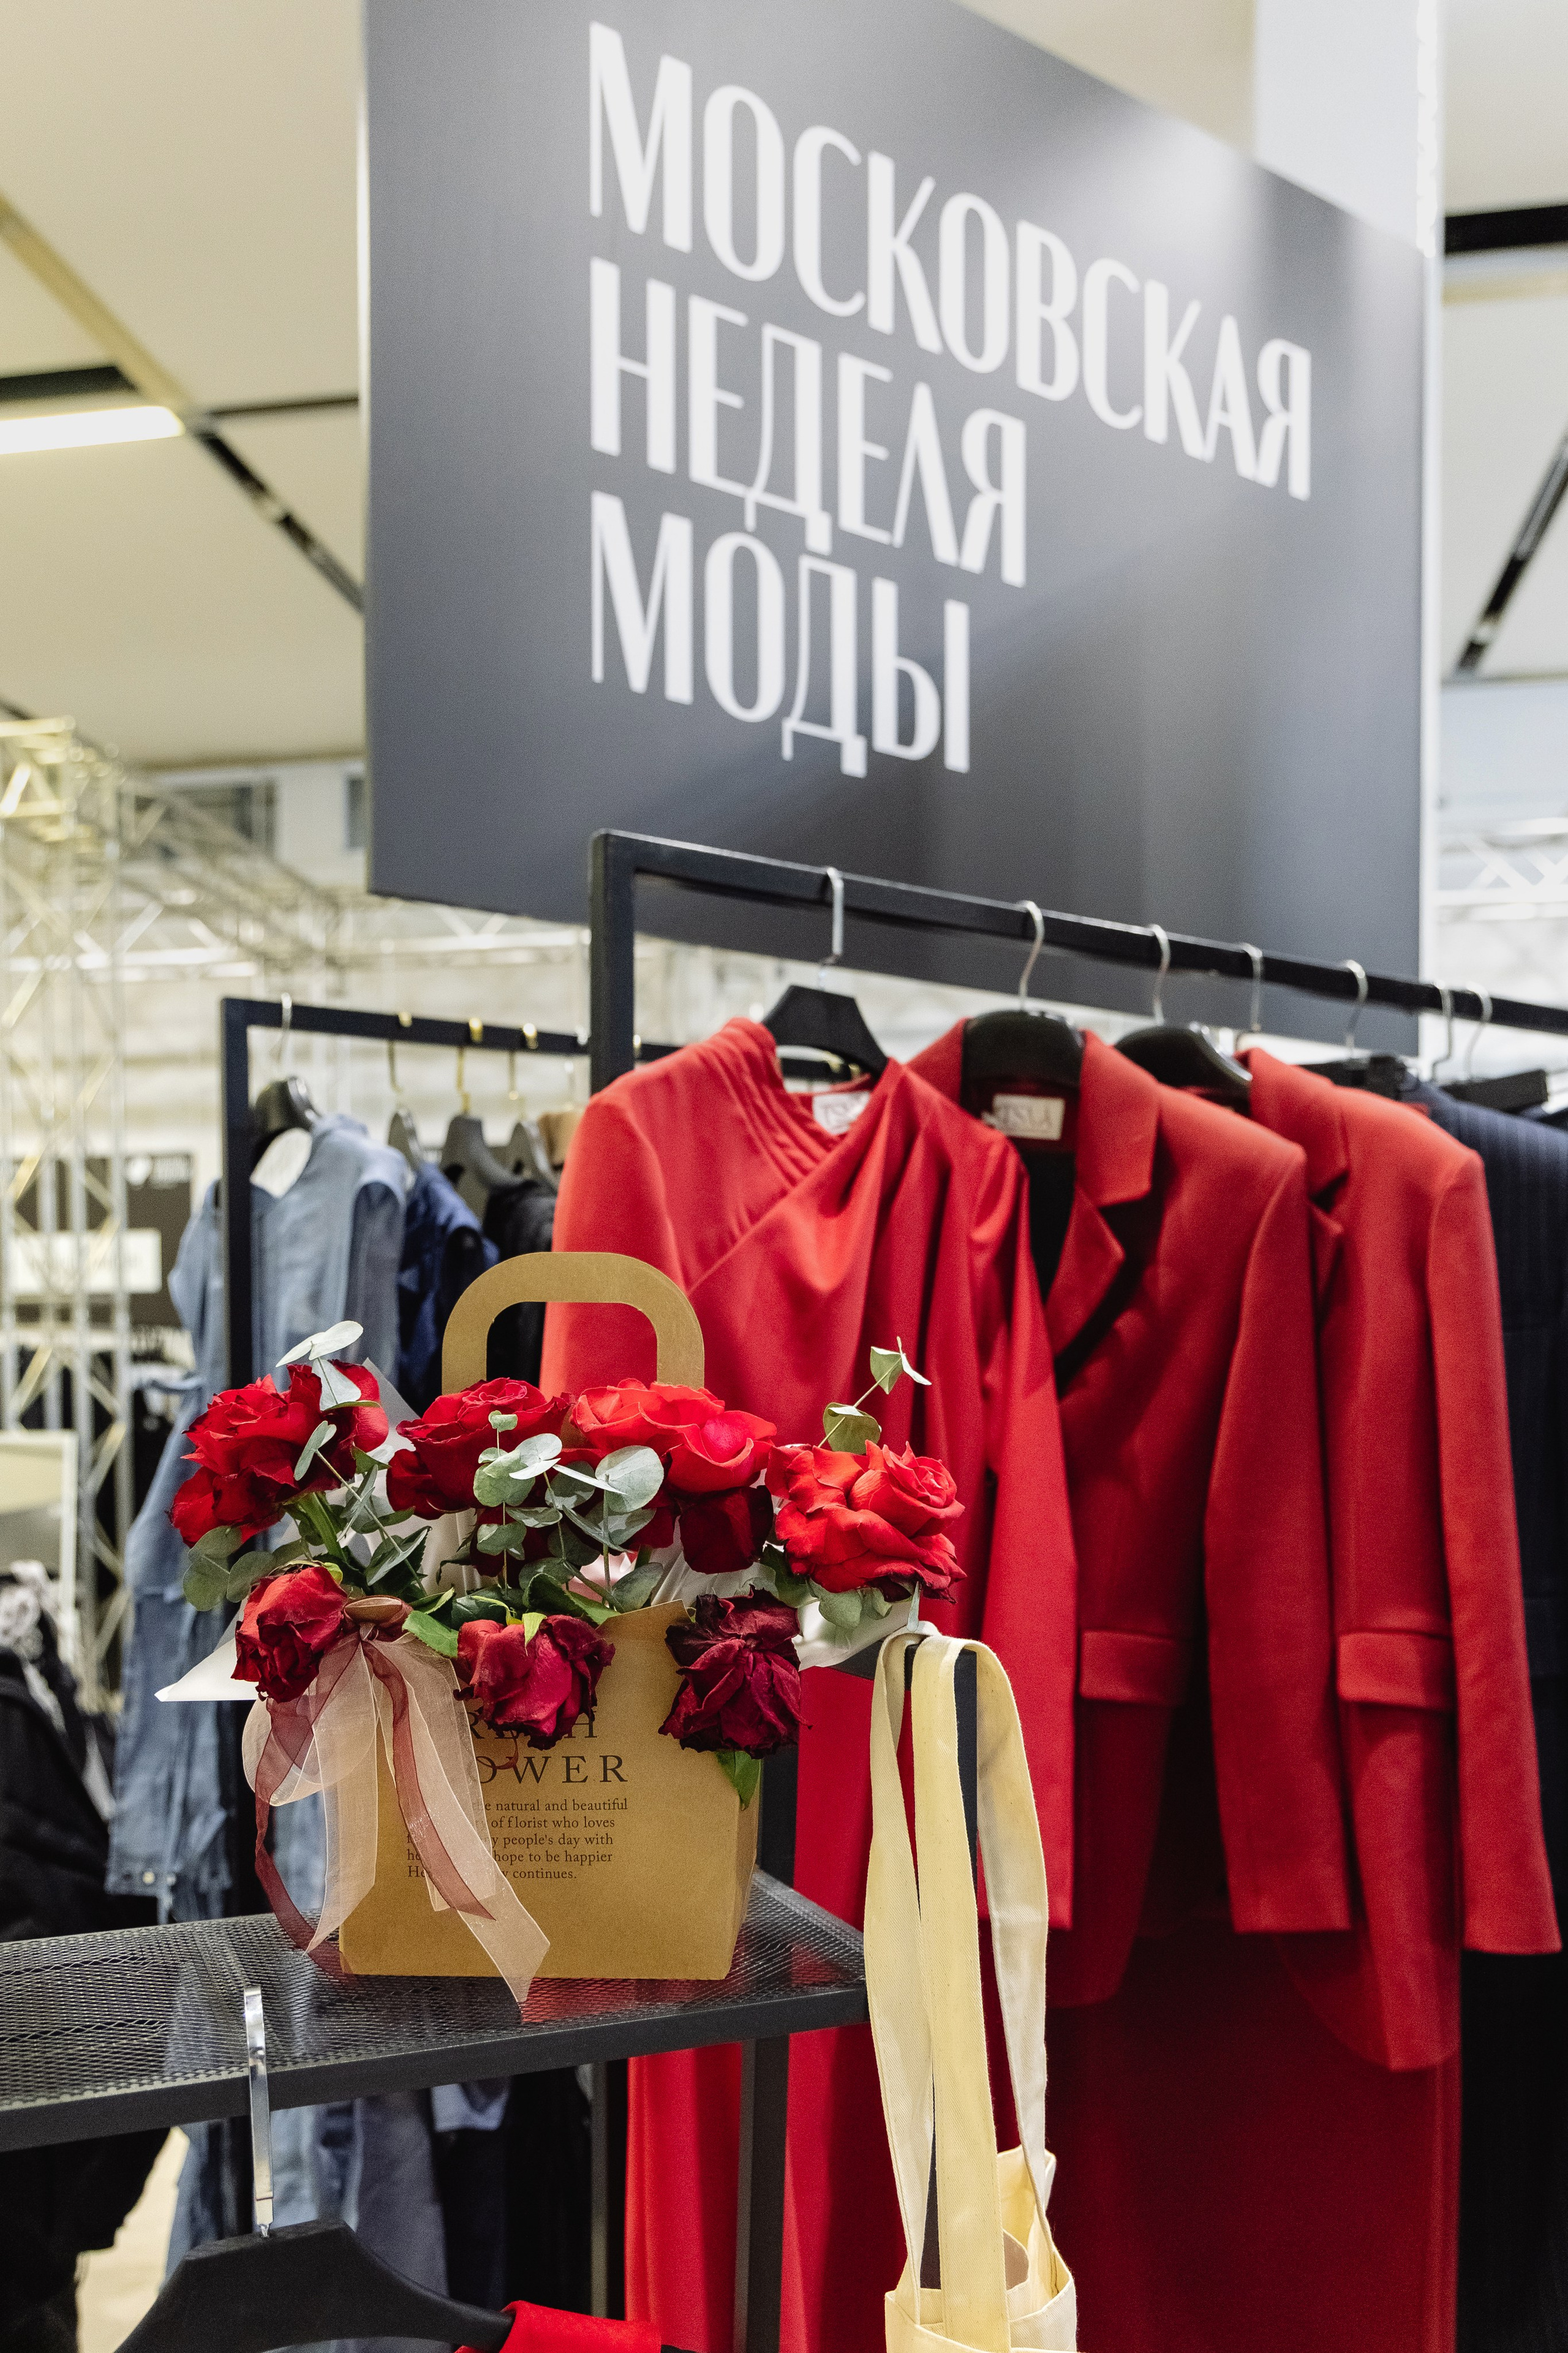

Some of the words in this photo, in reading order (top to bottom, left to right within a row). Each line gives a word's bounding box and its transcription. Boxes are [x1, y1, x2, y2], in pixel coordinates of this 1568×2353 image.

[589, 21, 1312, 501] МОСКОВСКАЯ
[590, 257, 1027, 589] НЕДЕЛЯ
[591, 490, 970, 779] МОДЫ
[476, 1754, 628, 1784] OWER
[496, 1799, 540, 1811] natural
[545, 1799, 567, 1811] and
[572, 1798, 628, 1811] beautiful
[491, 1816, 505, 1828] of
[507, 1816, 548, 1828] florist
[552, 1816, 579, 1828] who
[583, 1816, 615, 1828] loves
[503, 1834, 553, 1848] people's
[558, 1833, 580, 1848] day
[585, 1833, 613, 1845] with
[494, 1850, 524, 1865] hope
[529, 1852, 541, 1862] to
[546, 1850, 560, 1862] be
[565, 1850, 612, 1865] happier
[513, 1867, 577, 1879] continues.
